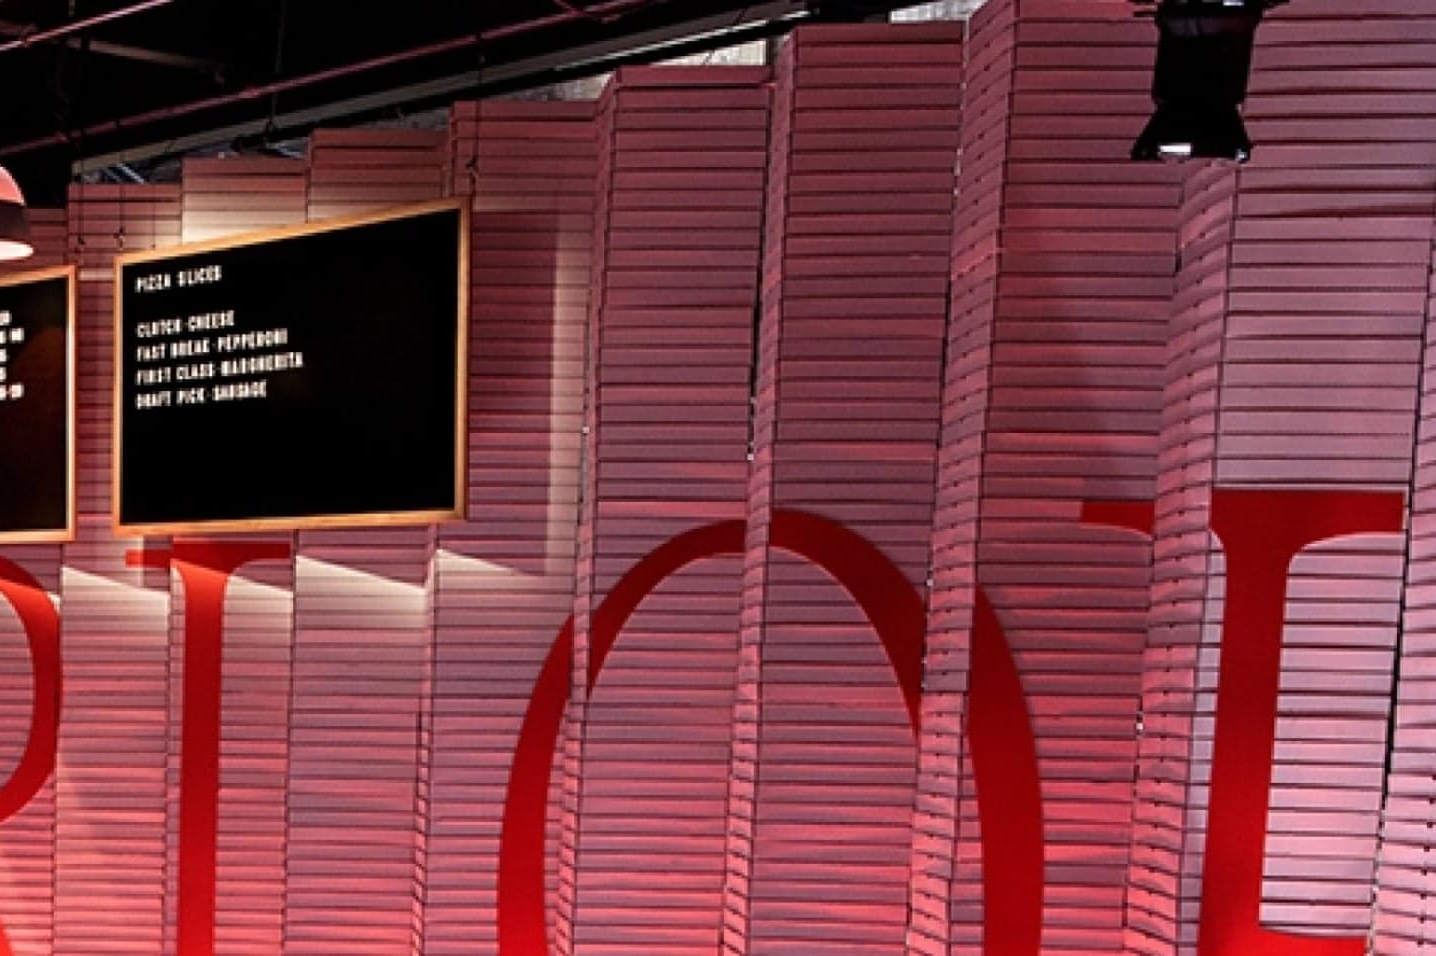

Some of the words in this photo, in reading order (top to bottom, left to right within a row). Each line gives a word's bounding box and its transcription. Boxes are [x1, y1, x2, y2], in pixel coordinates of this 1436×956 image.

[137, 274, 171, 292] PIZZA
[178, 265, 222, 287] SLICES
[137, 319, 181, 337] CLUTCH
[188, 310, 235, 332] CHEESE
[137, 344, 165, 361] FAST
[170, 339, 210, 358] BREAK
[218, 329, 288, 352] PEPPERONI
[137, 367, 171, 385] FIRST
[176, 363, 214, 380] CLASS
[220, 352, 304, 376] MARGHERITA
[137, 391, 171, 409] DRAFT
[176, 388, 205, 404] PICK
[212, 380, 267, 402] SAUSAGE
